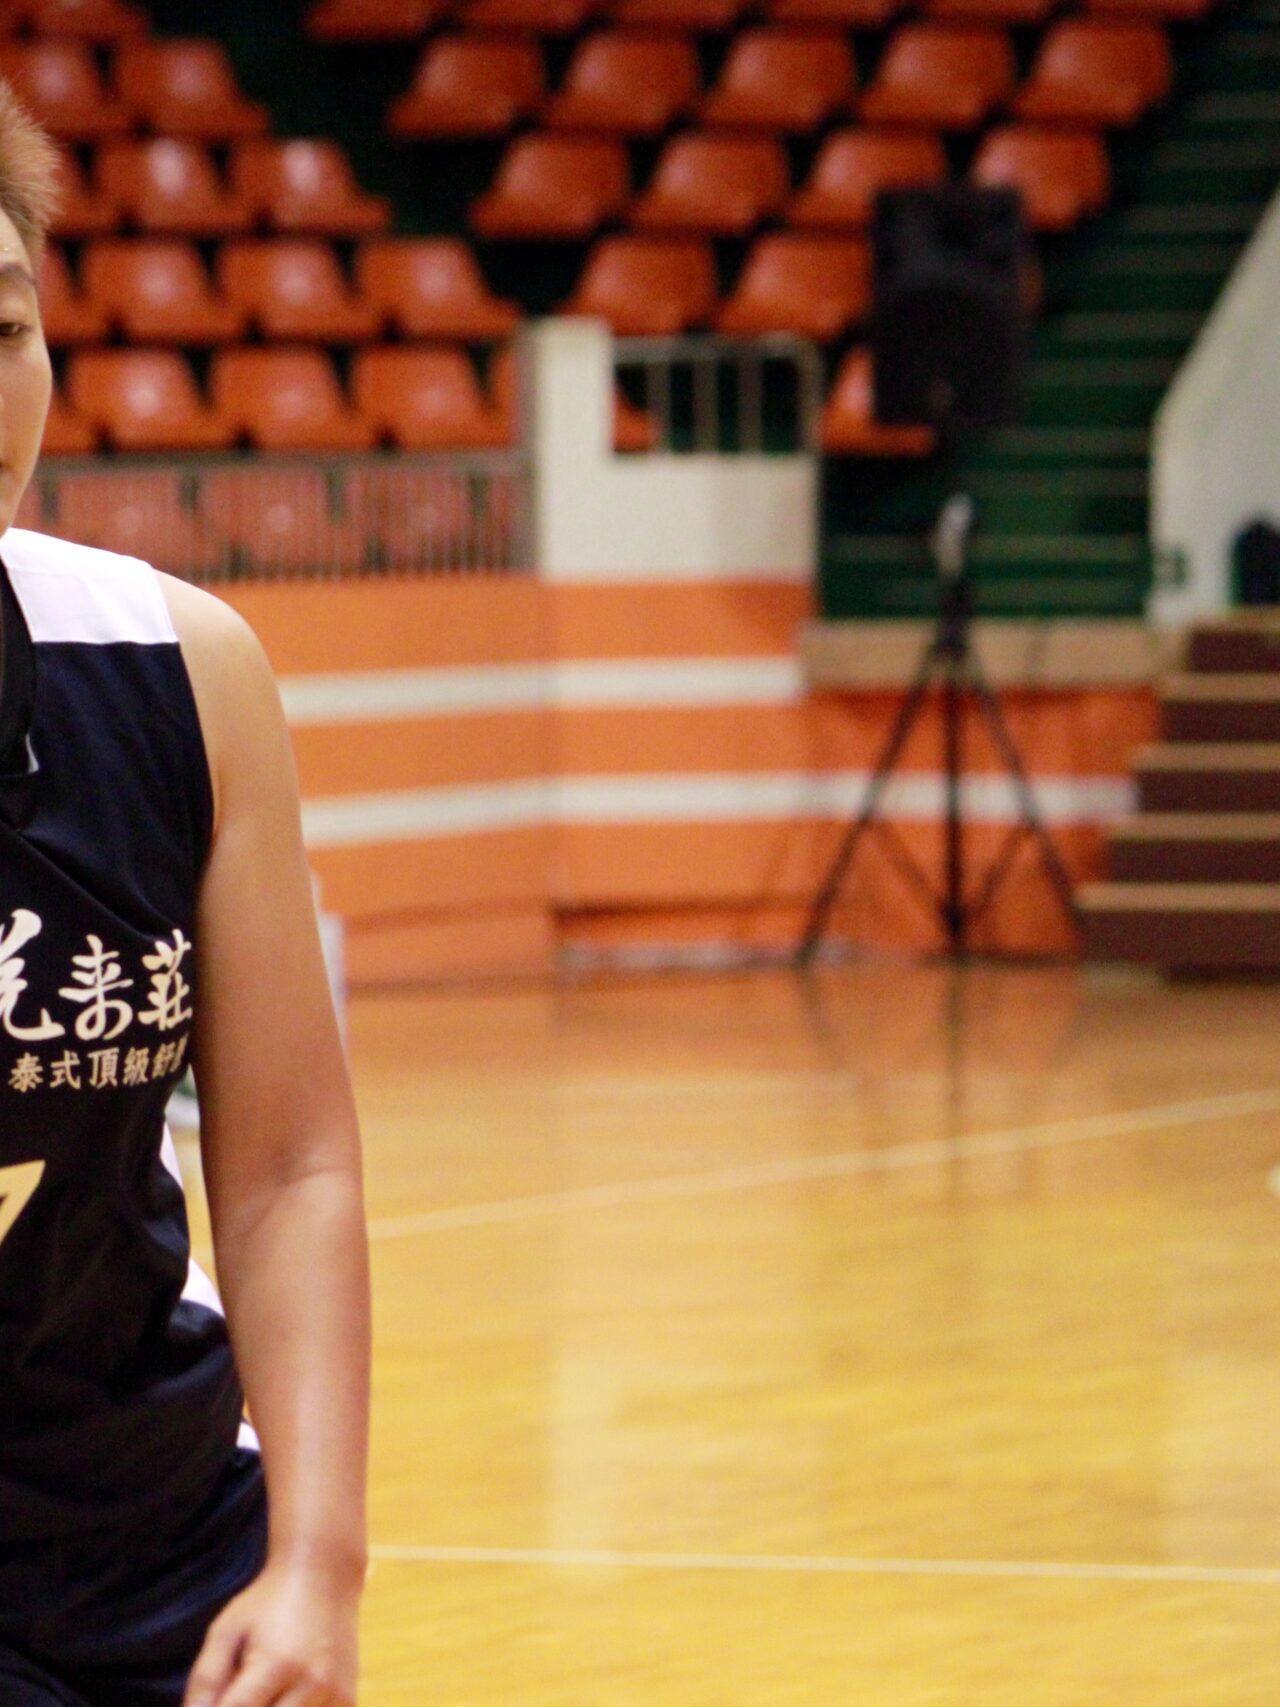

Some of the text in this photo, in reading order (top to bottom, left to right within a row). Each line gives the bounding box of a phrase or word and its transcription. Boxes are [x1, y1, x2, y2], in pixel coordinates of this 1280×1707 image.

[8, 1033, 189, 1093] 泰式頂級舒
